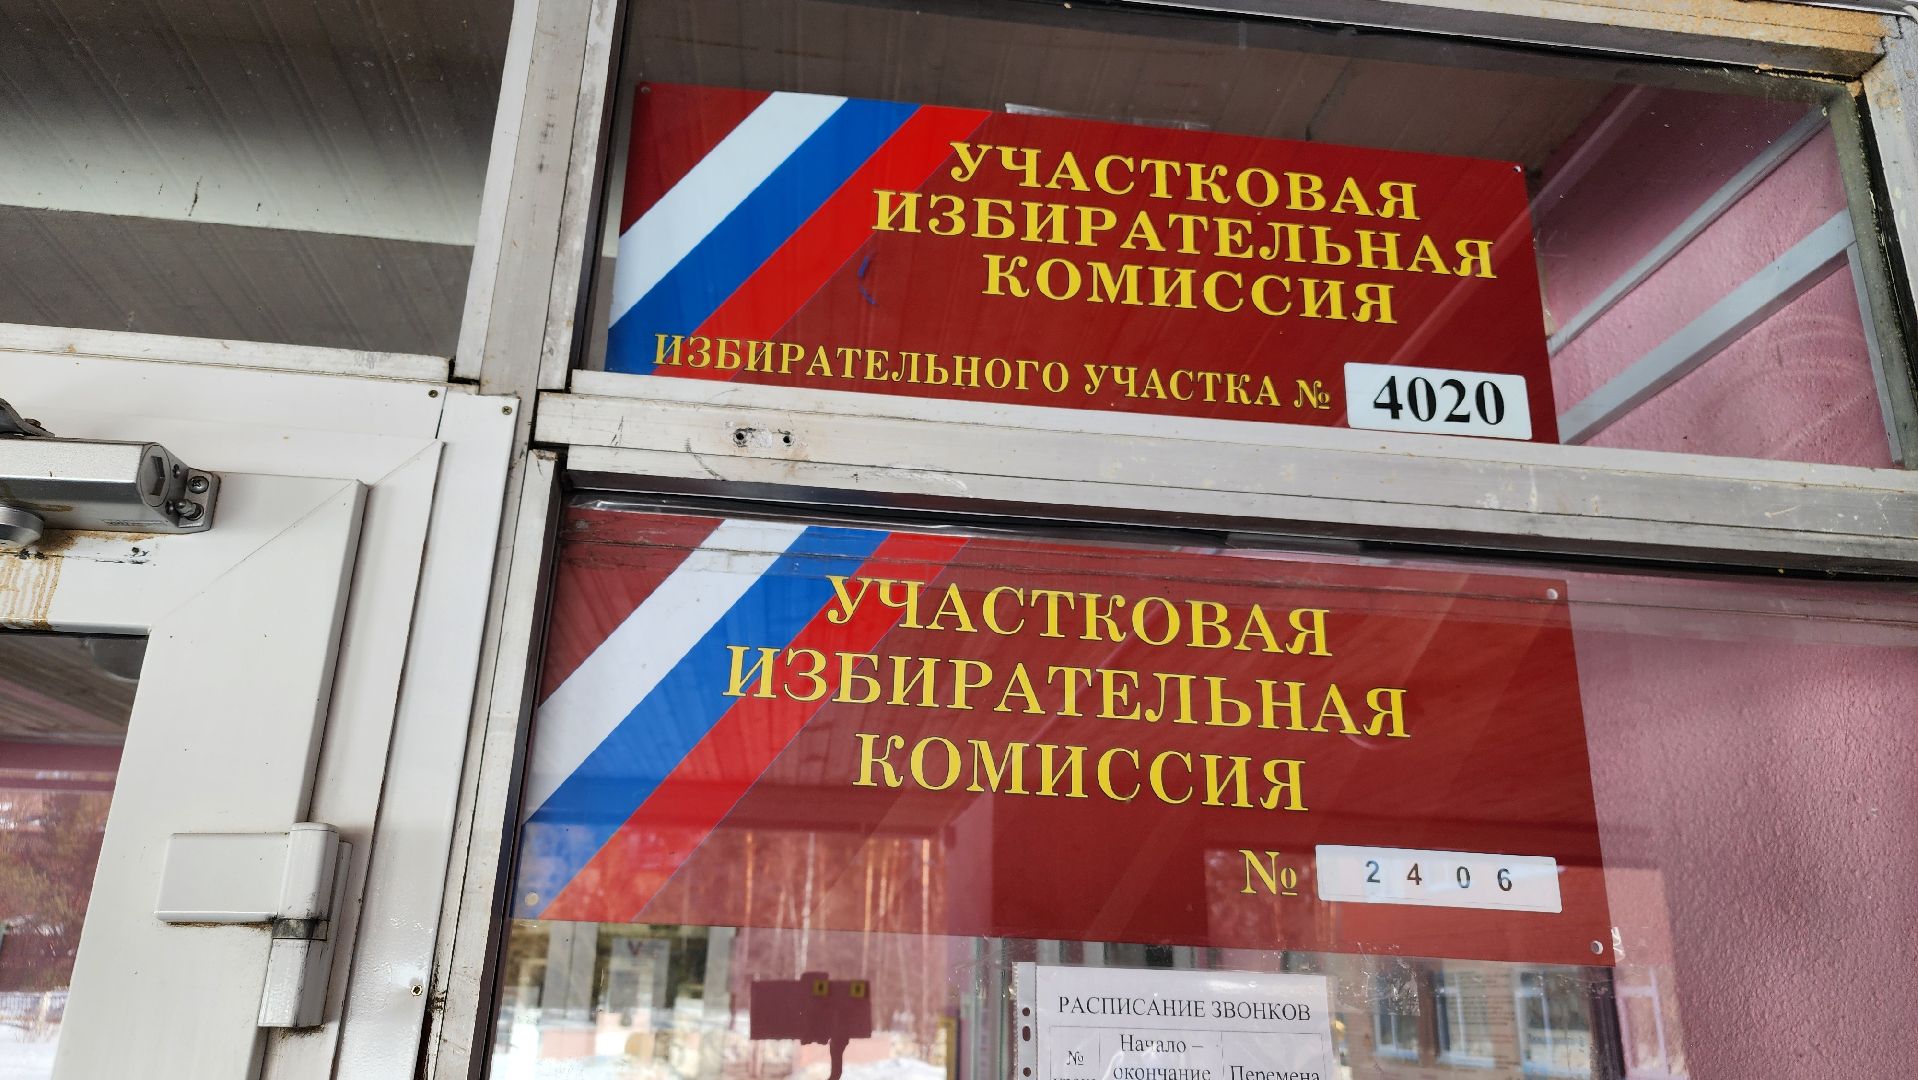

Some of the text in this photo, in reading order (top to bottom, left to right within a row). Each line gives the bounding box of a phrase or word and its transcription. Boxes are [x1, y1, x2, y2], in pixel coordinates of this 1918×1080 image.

[949, 140, 1421, 222] УЧАСТКОВАЯ
[871, 189, 1498, 280] ИЗБИРАТЕЛЬНАЯ
[982, 254, 1398, 326] КОМИССИЯ
[652, 332, 1506, 426] ИЗБИРАТЕЛЬНОГО УЧАСТКА № 4020
[825, 574, 1334, 658] УЧАСТКОВАЯ
[722, 644, 1411, 739] ИЗБИРАТЕЛЬНАЯ
[852, 732, 1310, 812] КОМИССИЯ
[1238, 849, 1298, 897] №
[1058, 995, 1311, 1022] РАСПИСАНИЕ ЗВОНКОВ
[1119, 1033, 1187, 1053] Начало
[1065, 1050, 1085, 1066] №
[1112, 1066, 1211, 1080] окончание
